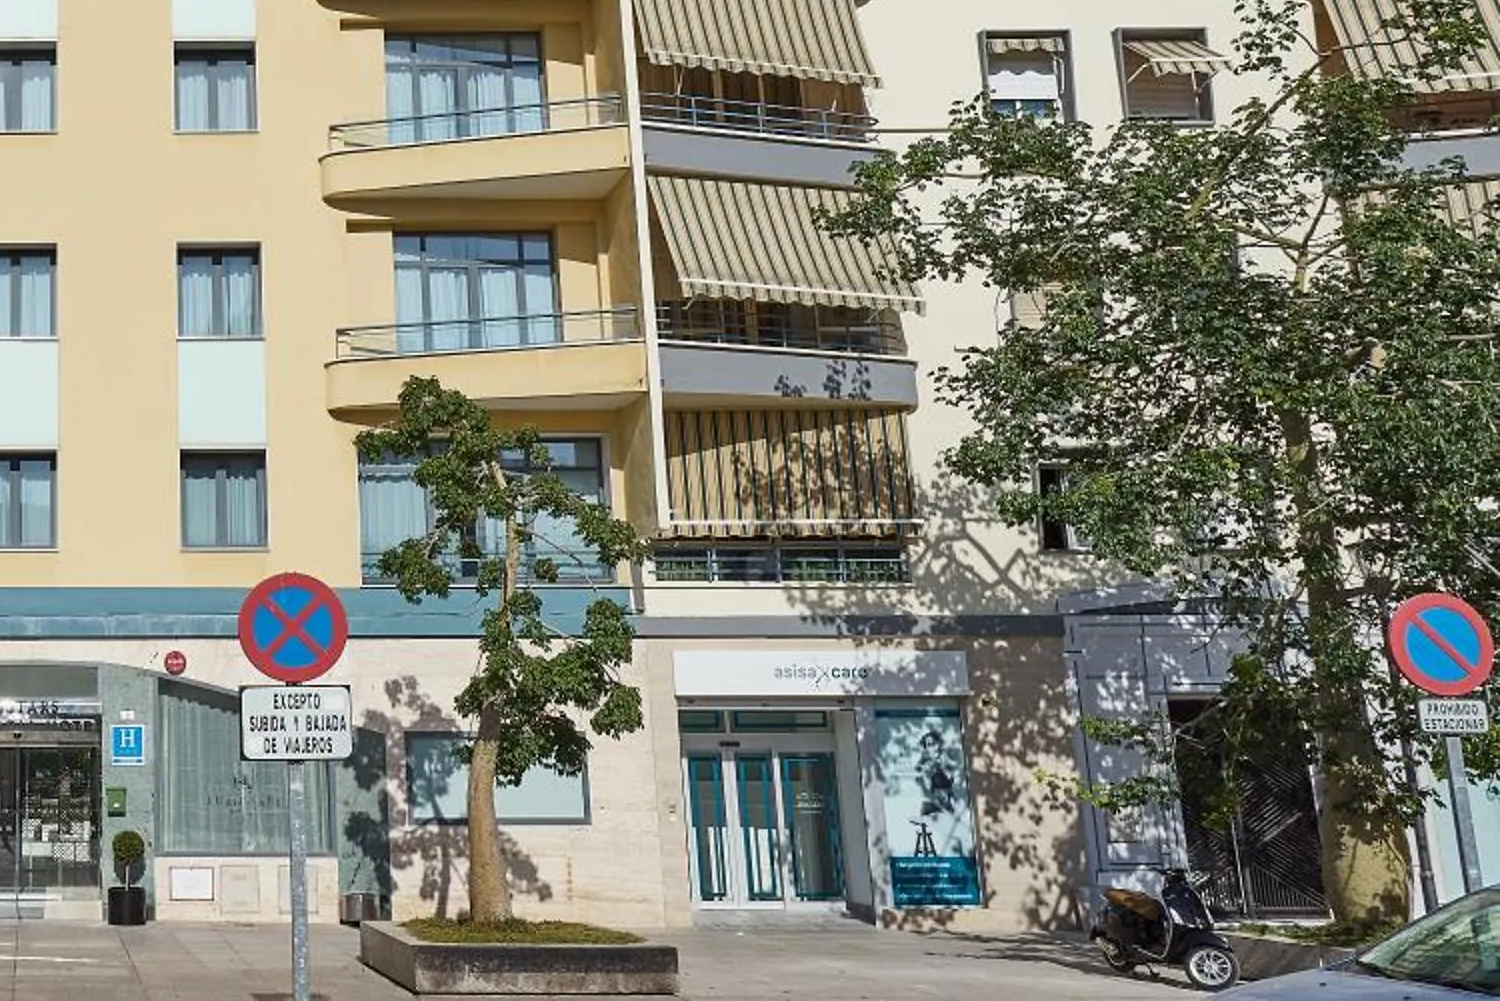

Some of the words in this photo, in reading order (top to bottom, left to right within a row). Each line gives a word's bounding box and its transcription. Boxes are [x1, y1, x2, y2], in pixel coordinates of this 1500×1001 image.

[773, 663, 817, 679] asisa
[831, 666, 869, 680] care
[273, 693, 321, 710] EXCEPTO
[1426, 702, 1479, 716] PROHIBIDO
[249, 715, 287, 732] SUBIDA
[293, 715, 300, 731] Y
[305, 714, 347, 732] BAJADA
[1423, 718, 1486, 730] ESTACIONAR
[119, 729, 135, 748] H
[263, 737, 278, 754] DE
[283, 737, 334, 754] VIAJEROS
